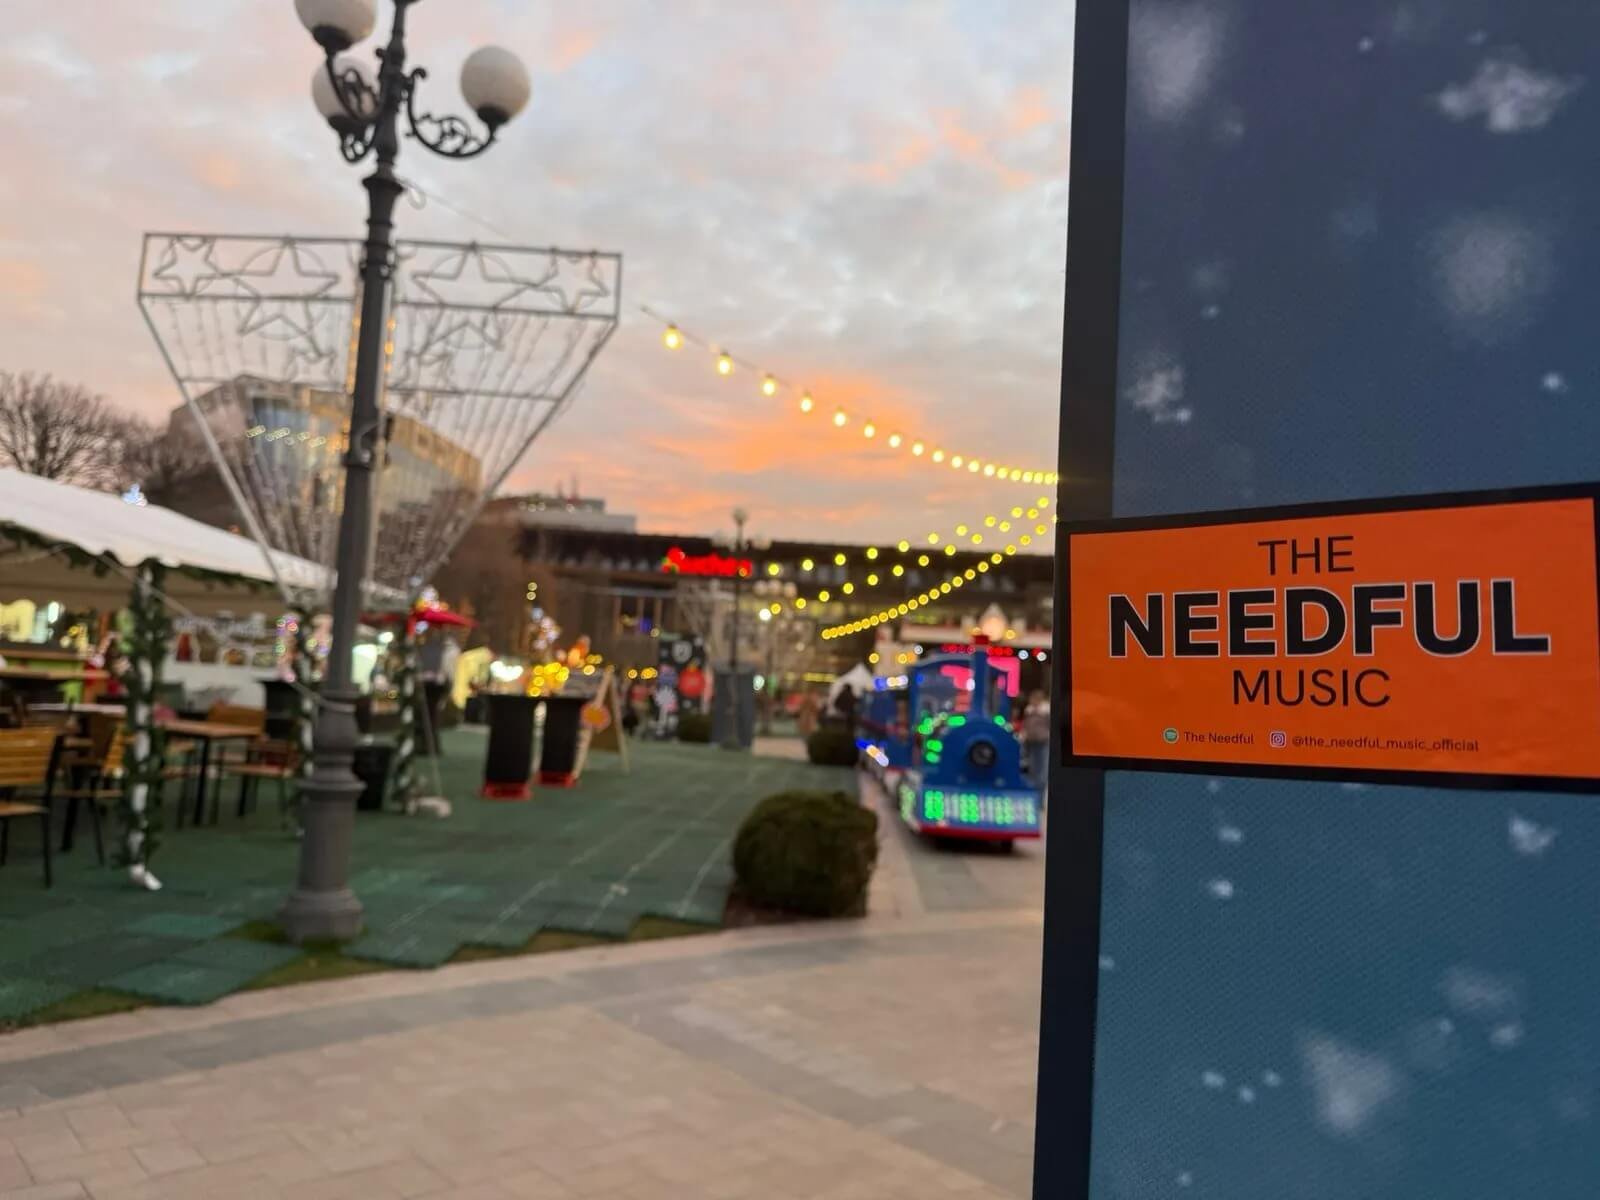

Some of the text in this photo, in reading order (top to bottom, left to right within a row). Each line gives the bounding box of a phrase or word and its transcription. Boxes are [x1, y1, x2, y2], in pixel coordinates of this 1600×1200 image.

[1257, 535, 1355, 576] THE
[1107, 577, 1552, 658] NEEDFUL
[1232, 668, 1392, 708] MUSIC
[1184, 731, 1255, 745] The Needful
[1291, 735, 1480, 752] @the_needful_music_official
